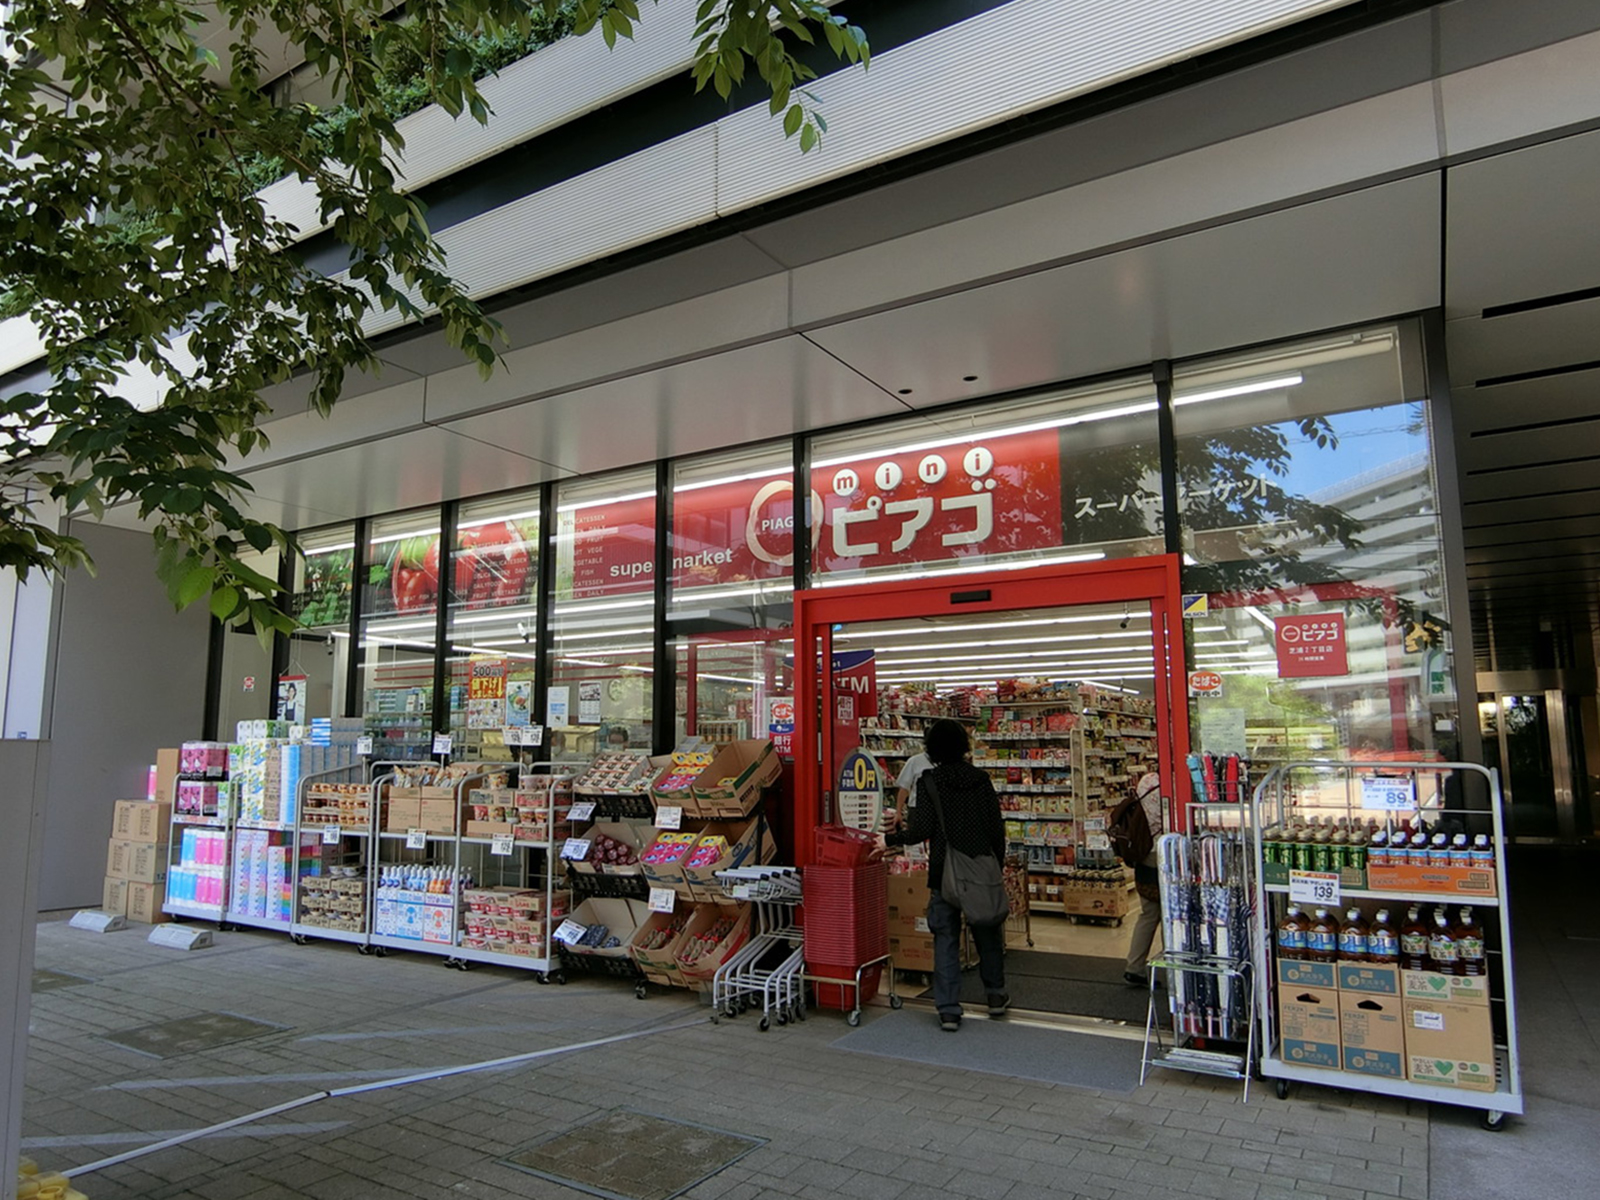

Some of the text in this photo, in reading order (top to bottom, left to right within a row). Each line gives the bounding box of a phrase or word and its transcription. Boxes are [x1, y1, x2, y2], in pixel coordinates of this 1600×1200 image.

[837, 453, 981, 490] mini
[1074, 473, 1277, 519] スーパーーケット
[832, 478, 994, 557] ピアゴ
[1302, 627, 1339, 641] ピアゴ
[833, 675, 869, 694] TM
[1192, 675, 1219, 687] たばこ
[1386, 792, 1407, 804] 89
[1314, 886, 1333, 898] 139
